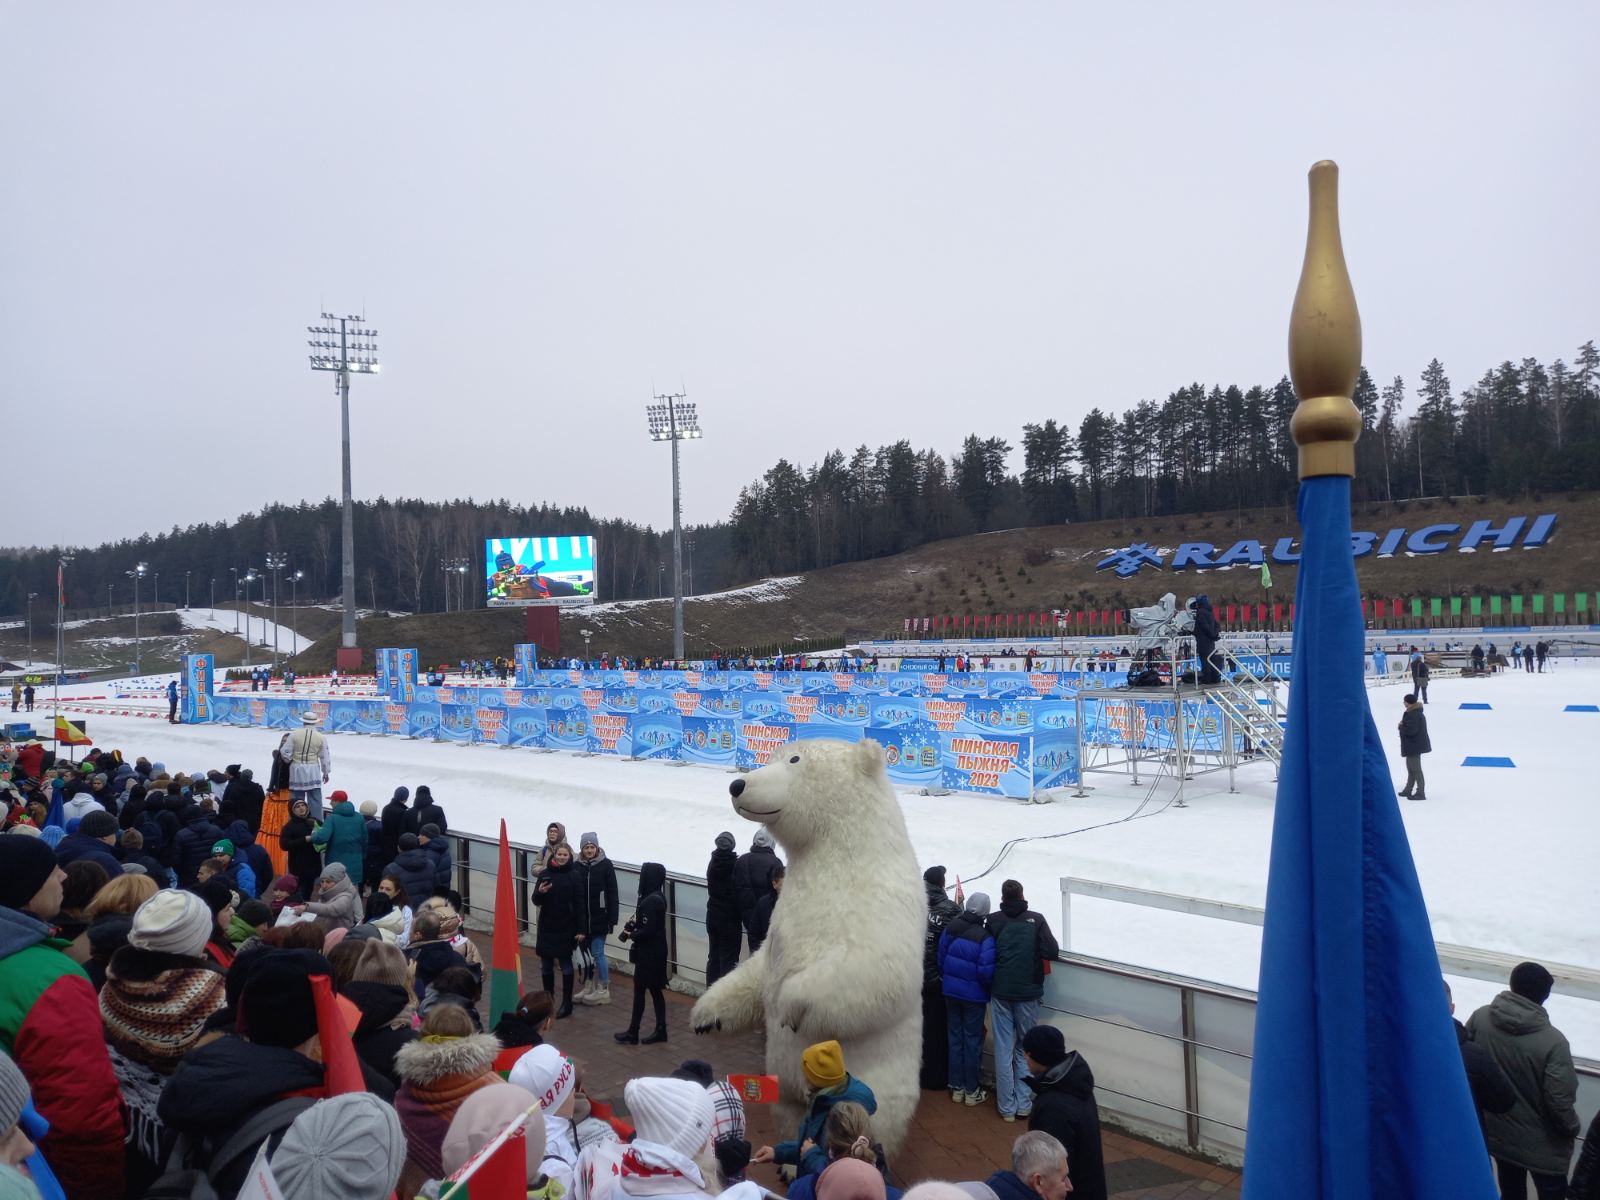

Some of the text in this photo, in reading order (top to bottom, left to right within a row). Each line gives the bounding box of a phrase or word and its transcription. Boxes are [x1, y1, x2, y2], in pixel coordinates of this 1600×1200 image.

[196, 658, 207, 718] ФИНИШ
[785, 695, 818, 705] МИНСКАЯ
[925, 700, 966, 712] МИНСКАЯ
[591, 714, 627, 727] МИНСКАЯ
[936, 721, 955, 731] 2023
[742, 723, 790, 740] МИНСКАЯ
[950, 738, 1020, 758] МИНСКАЯ
[754, 752, 771, 765] 202
[968, 771, 1000, 789] 2023
[552, 1063, 573, 1096] РУСЬ
